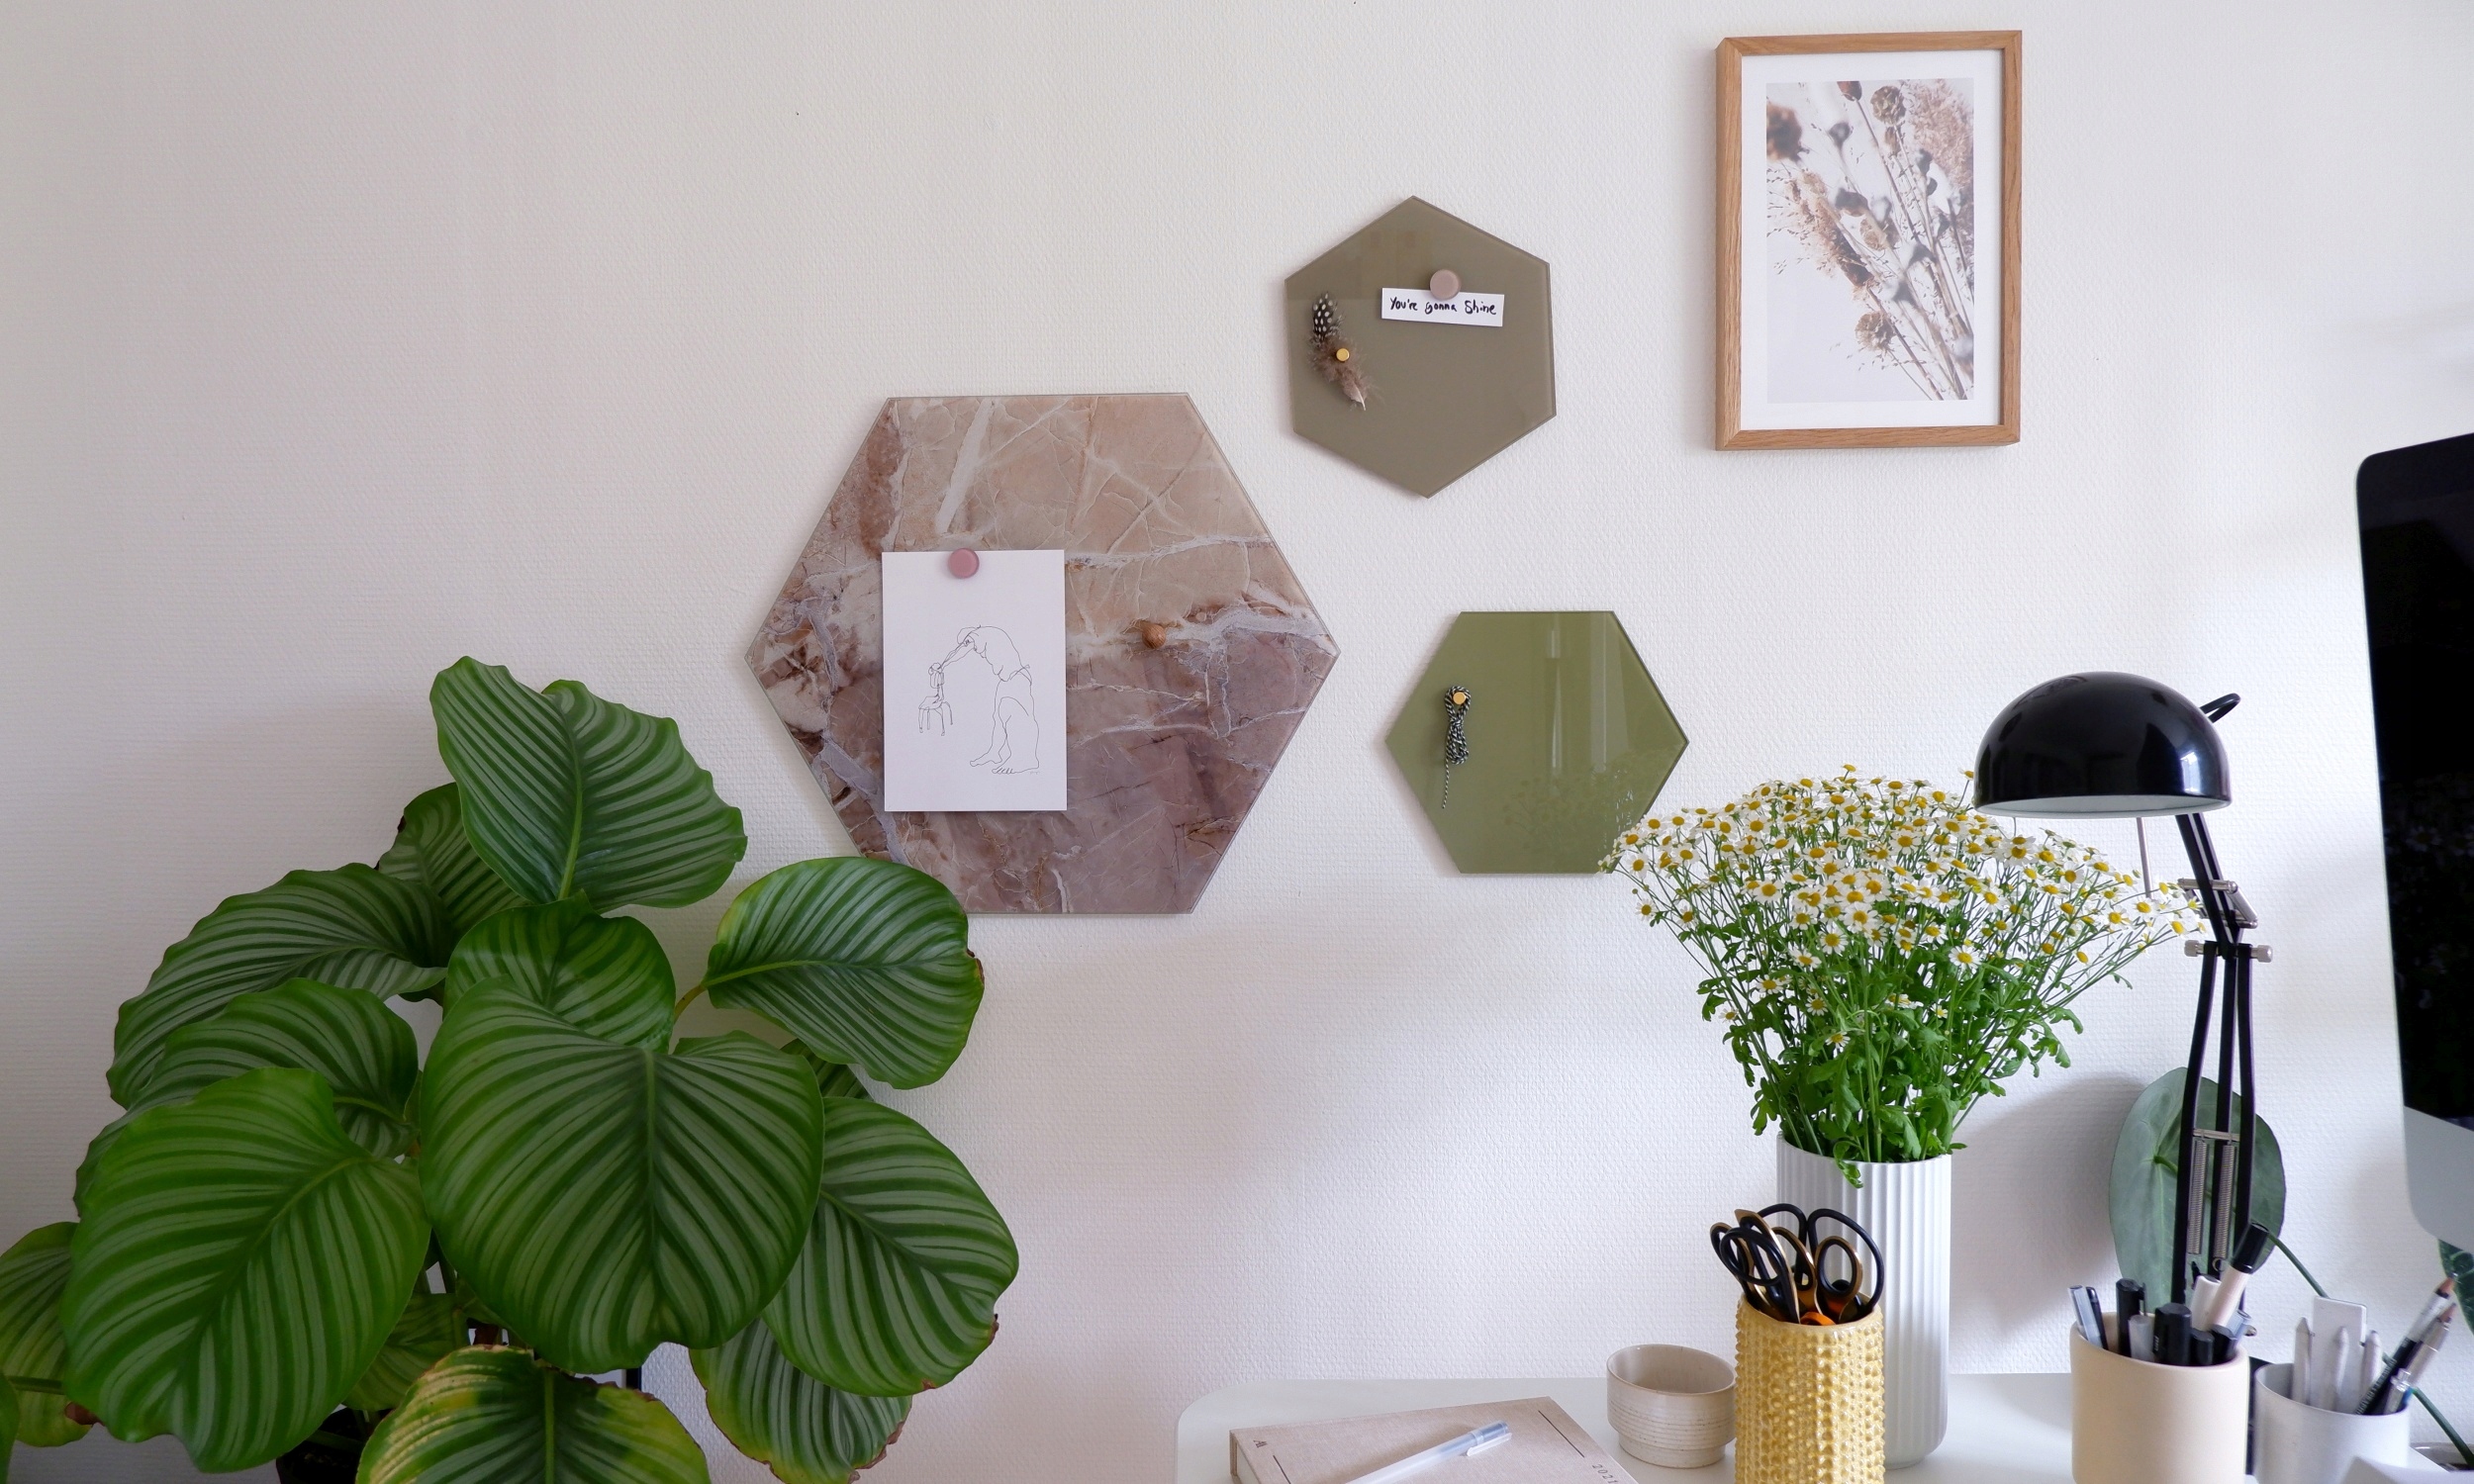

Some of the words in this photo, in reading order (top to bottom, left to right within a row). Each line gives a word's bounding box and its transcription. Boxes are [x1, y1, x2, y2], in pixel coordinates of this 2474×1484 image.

[1389, 296, 1418, 312] You're
[1424, 301, 1458, 316] gonna
[1464, 299, 1497, 316] Shine
[1591, 1463, 1619, 1484] 2021
